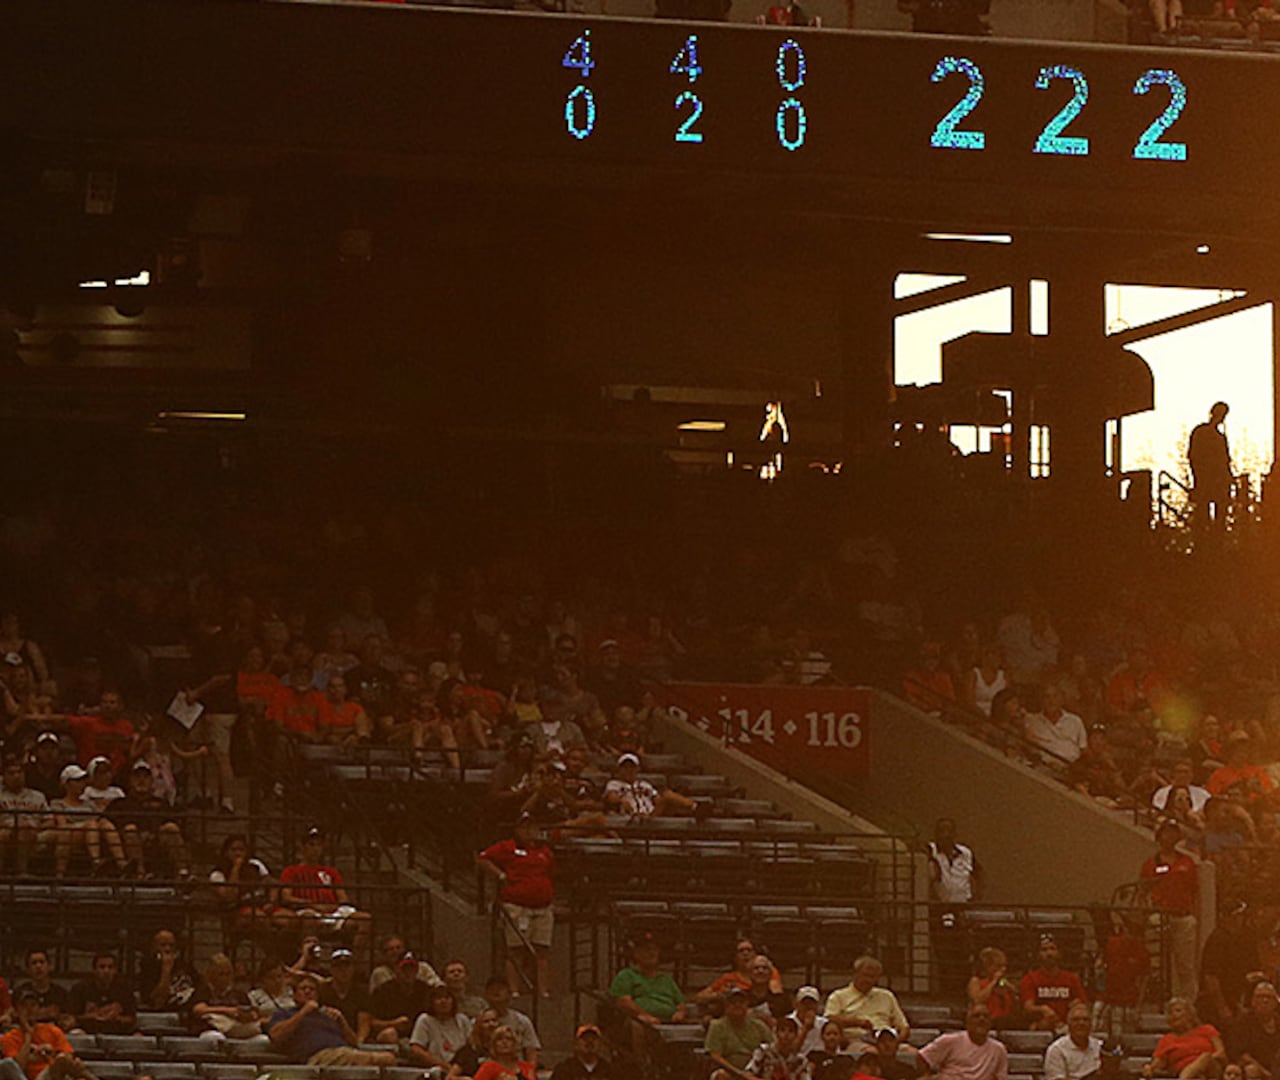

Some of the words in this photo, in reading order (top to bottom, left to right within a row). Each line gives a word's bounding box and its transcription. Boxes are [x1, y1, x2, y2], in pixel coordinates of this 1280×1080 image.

[562, 30, 595, 77] 4
[670, 35, 703, 82] 4
[777, 39, 807, 91] 0
[565, 86, 595, 140] 0
[675, 92, 703, 143] 2
[777, 98, 807, 150] 0
[930, 56, 985, 149] 2
[1033, 65, 1089, 155] 2
[1132, 68, 1187, 161] 2
[805, 711, 862, 748] 116
